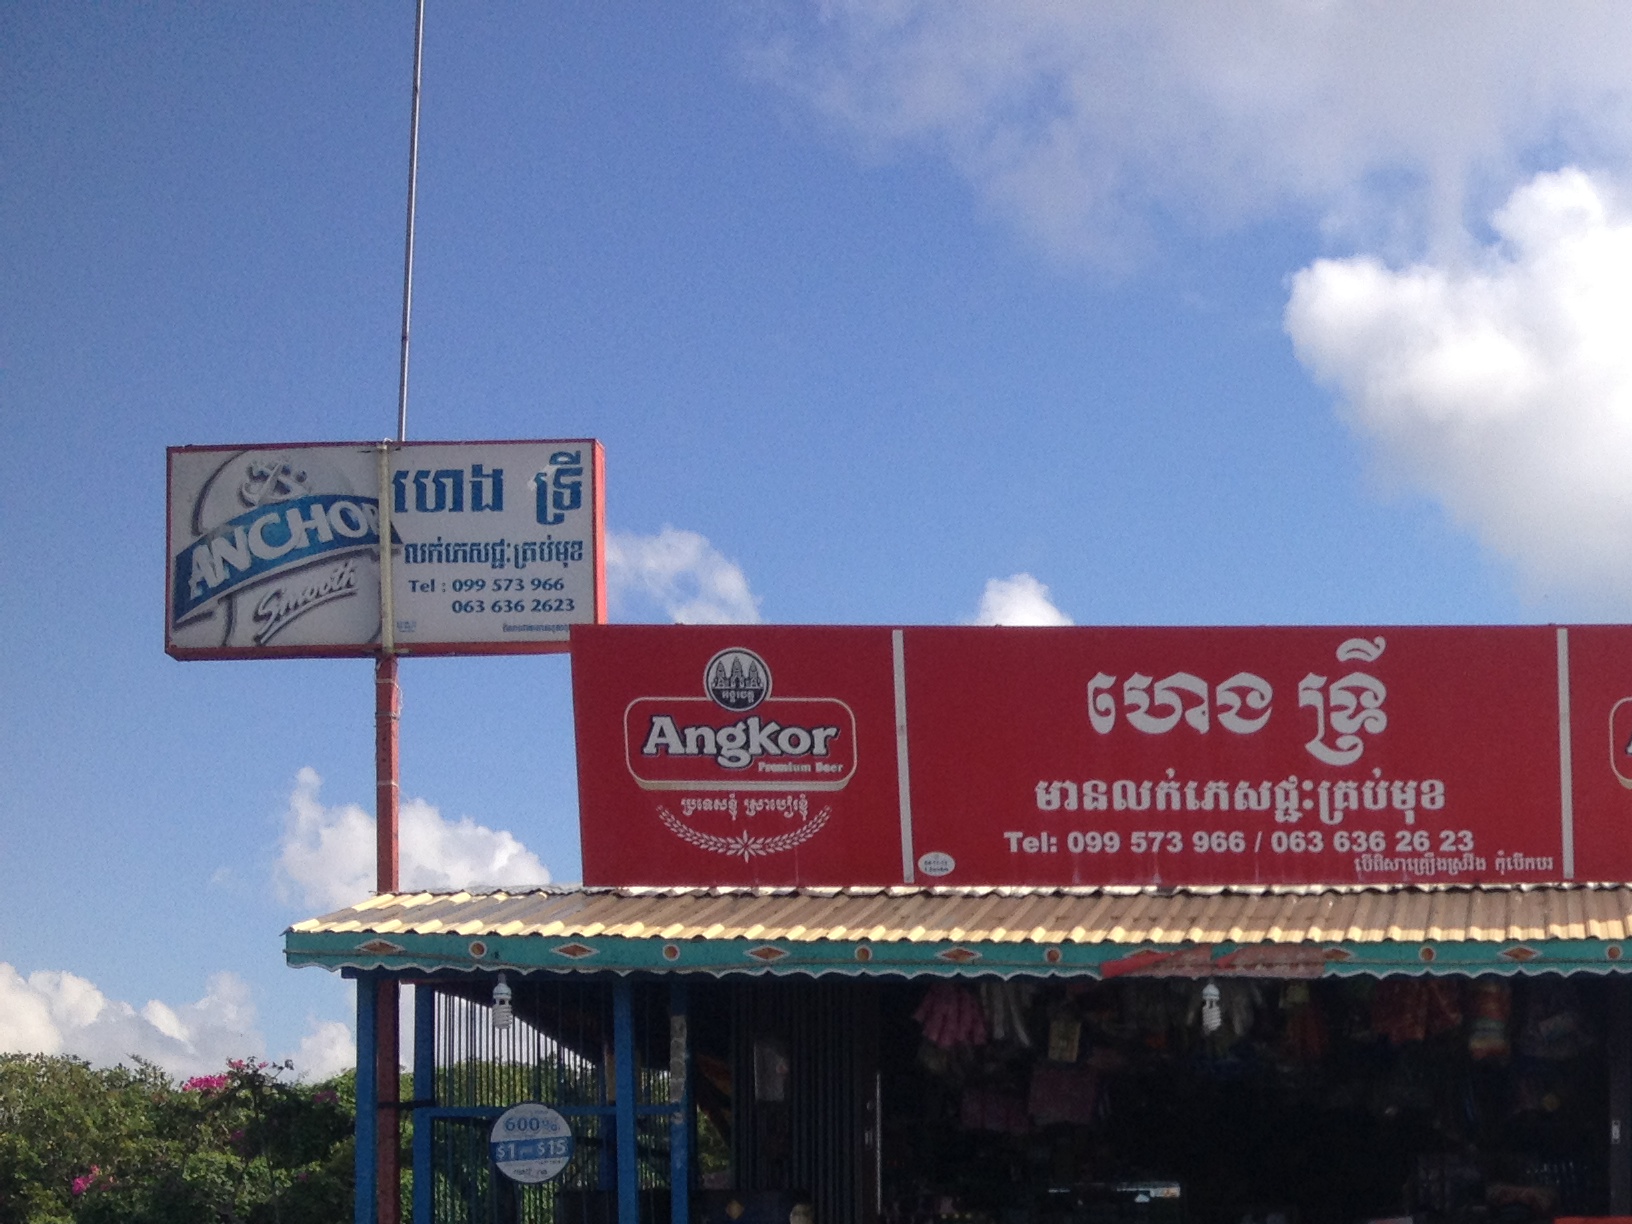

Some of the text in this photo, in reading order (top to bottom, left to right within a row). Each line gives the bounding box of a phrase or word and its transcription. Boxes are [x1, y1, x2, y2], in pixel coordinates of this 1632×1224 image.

[452, 579, 486, 592] 099
[492, 578, 525, 592] 573
[531, 578, 565, 591] 966
[452, 598, 576, 613] 063 636 2623
[642, 714, 840, 769] Angkor
[815, 761, 844, 772] Beer
[1003, 831, 1057, 853] Tel:
[1067, 831, 1120, 853] 099
[1131, 831, 1183, 853] 573
[1192, 831, 1246, 852] 966
[1271, 831, 1324, 853] 063
[1333, 831, 1386, 852] 636
[1396, 830, 1430, 851] 26
[1439, 830, 1475, 851] 23
